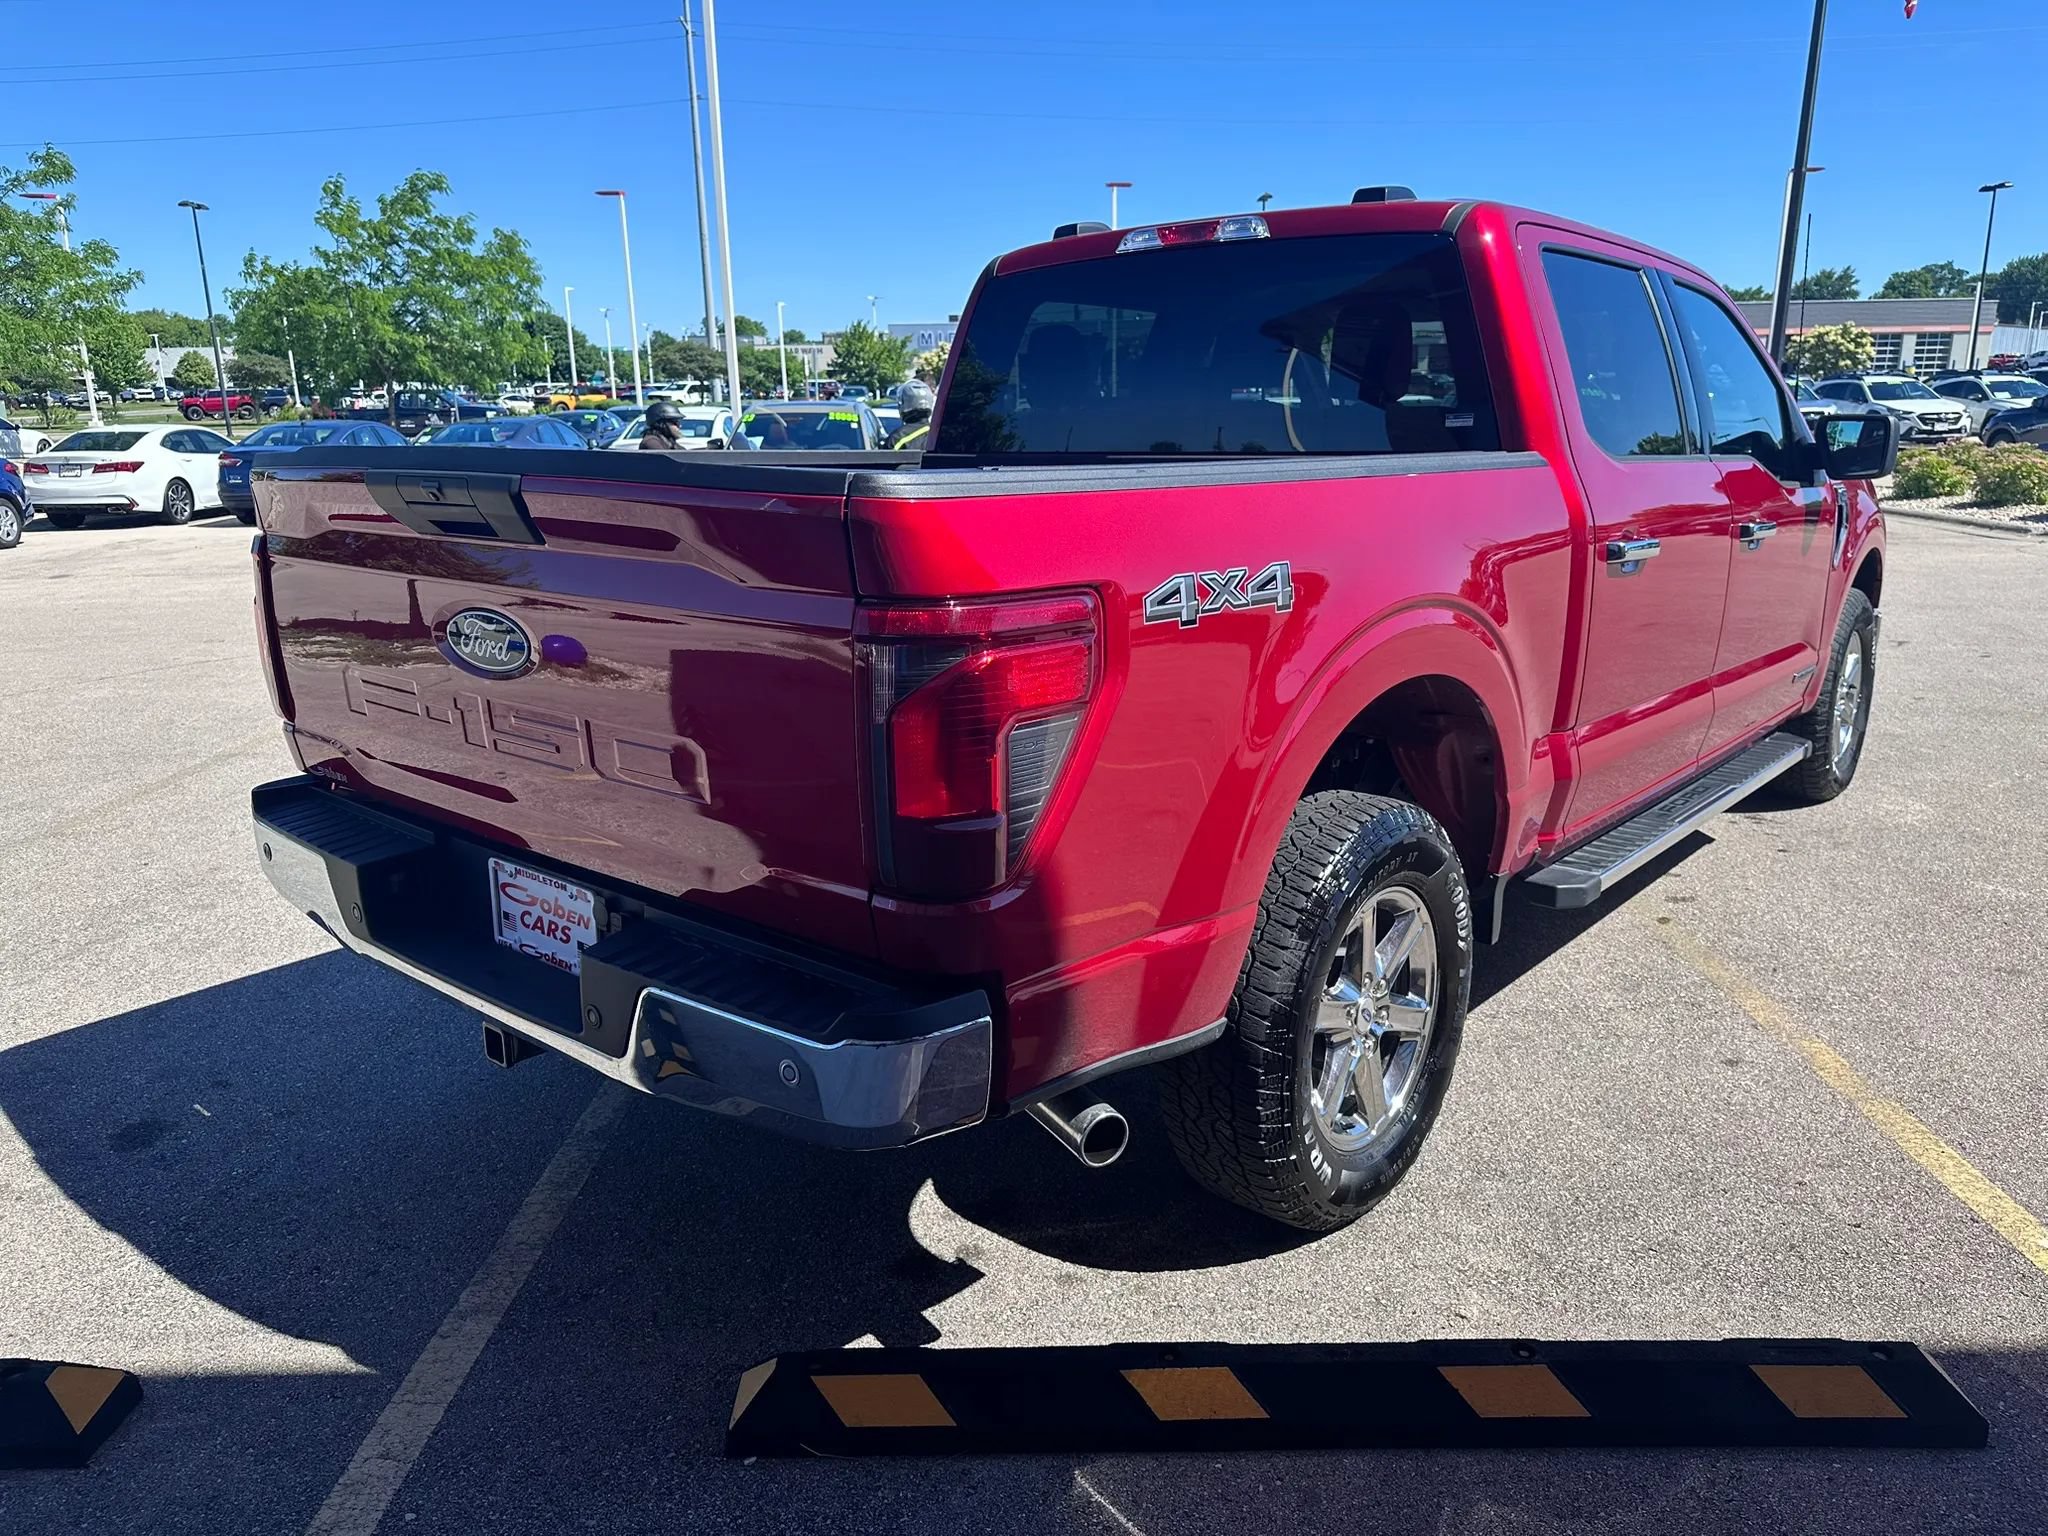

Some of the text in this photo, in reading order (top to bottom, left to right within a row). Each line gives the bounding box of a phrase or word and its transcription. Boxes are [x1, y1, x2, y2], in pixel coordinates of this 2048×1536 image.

[460, 618, 511, 662] Ford
[342, 665, 711, 805] F-150
[1657, 786, 1712, 817] FORD
[514, 866, 568, 892] MIDDLETON
[520, 910, 572, 945] CARS
